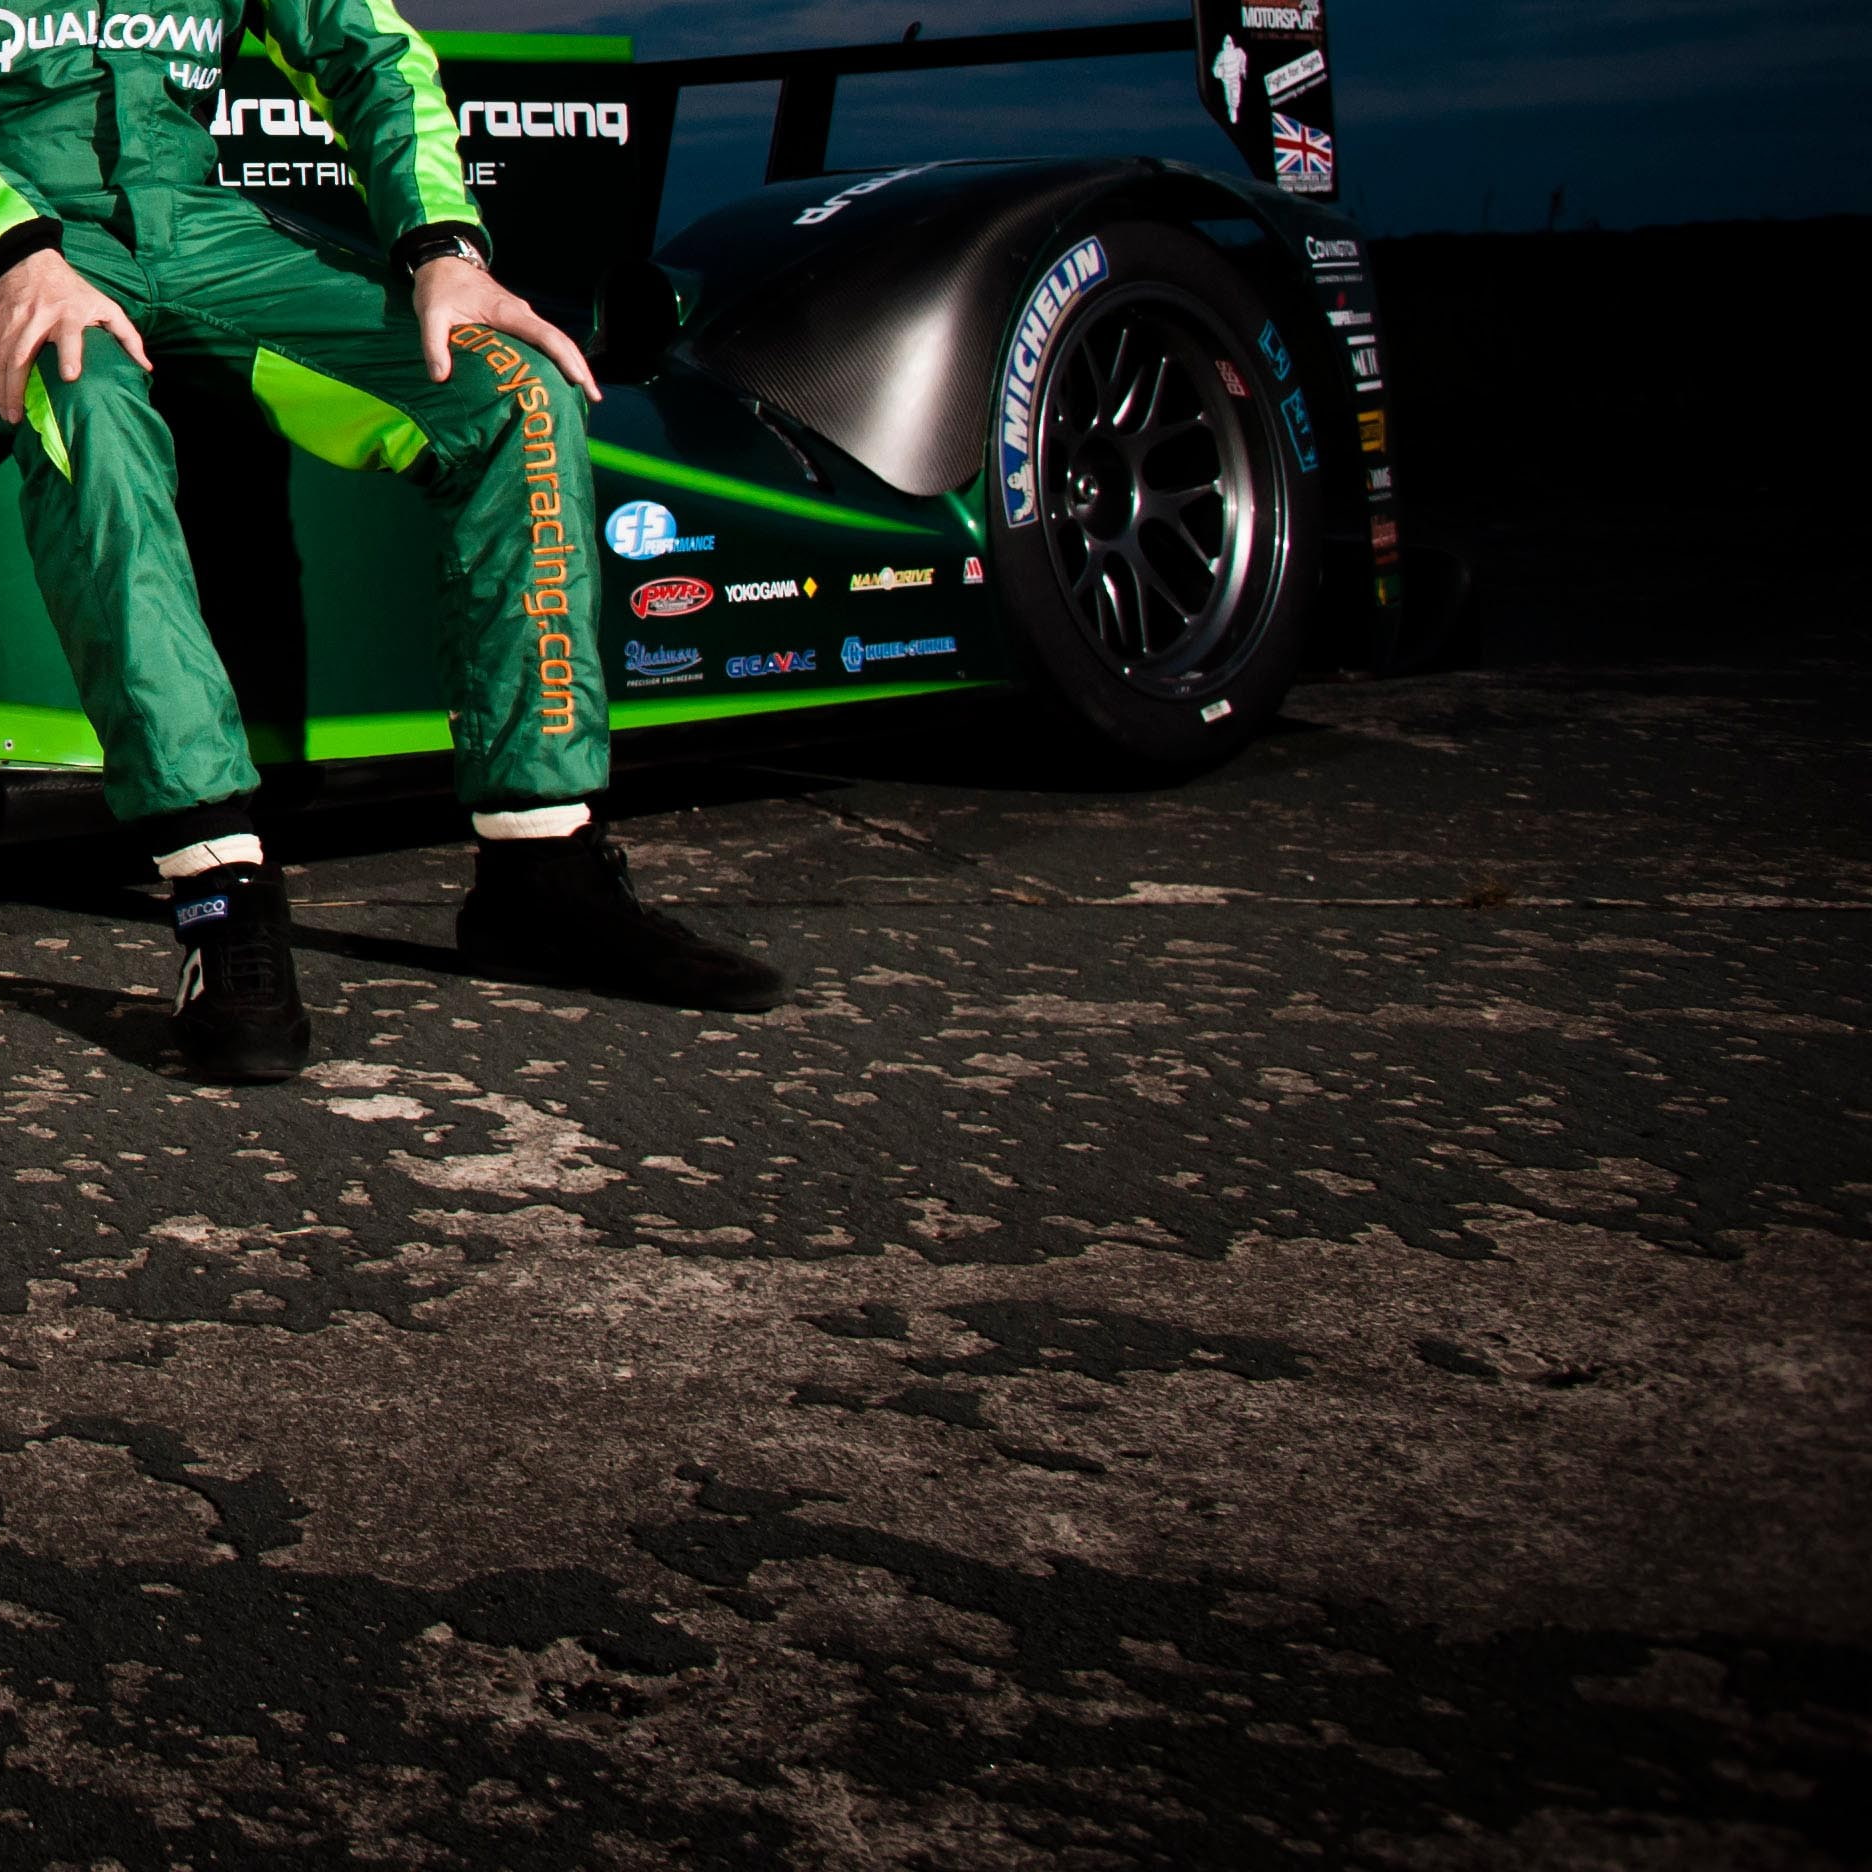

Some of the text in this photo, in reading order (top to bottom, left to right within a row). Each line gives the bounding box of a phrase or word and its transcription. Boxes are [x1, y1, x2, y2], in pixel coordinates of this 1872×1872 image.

[169, 61, 217, 89] HALO
[458, 101, 629, 146] racing
[1003, 241, 1100, 454] MICHELIN
[451, 324, 576, 735] draysonracing.com
[725, 580, 799, 603] YOKOGAWA
[726, 649, 816, 678] GIGAVAC
